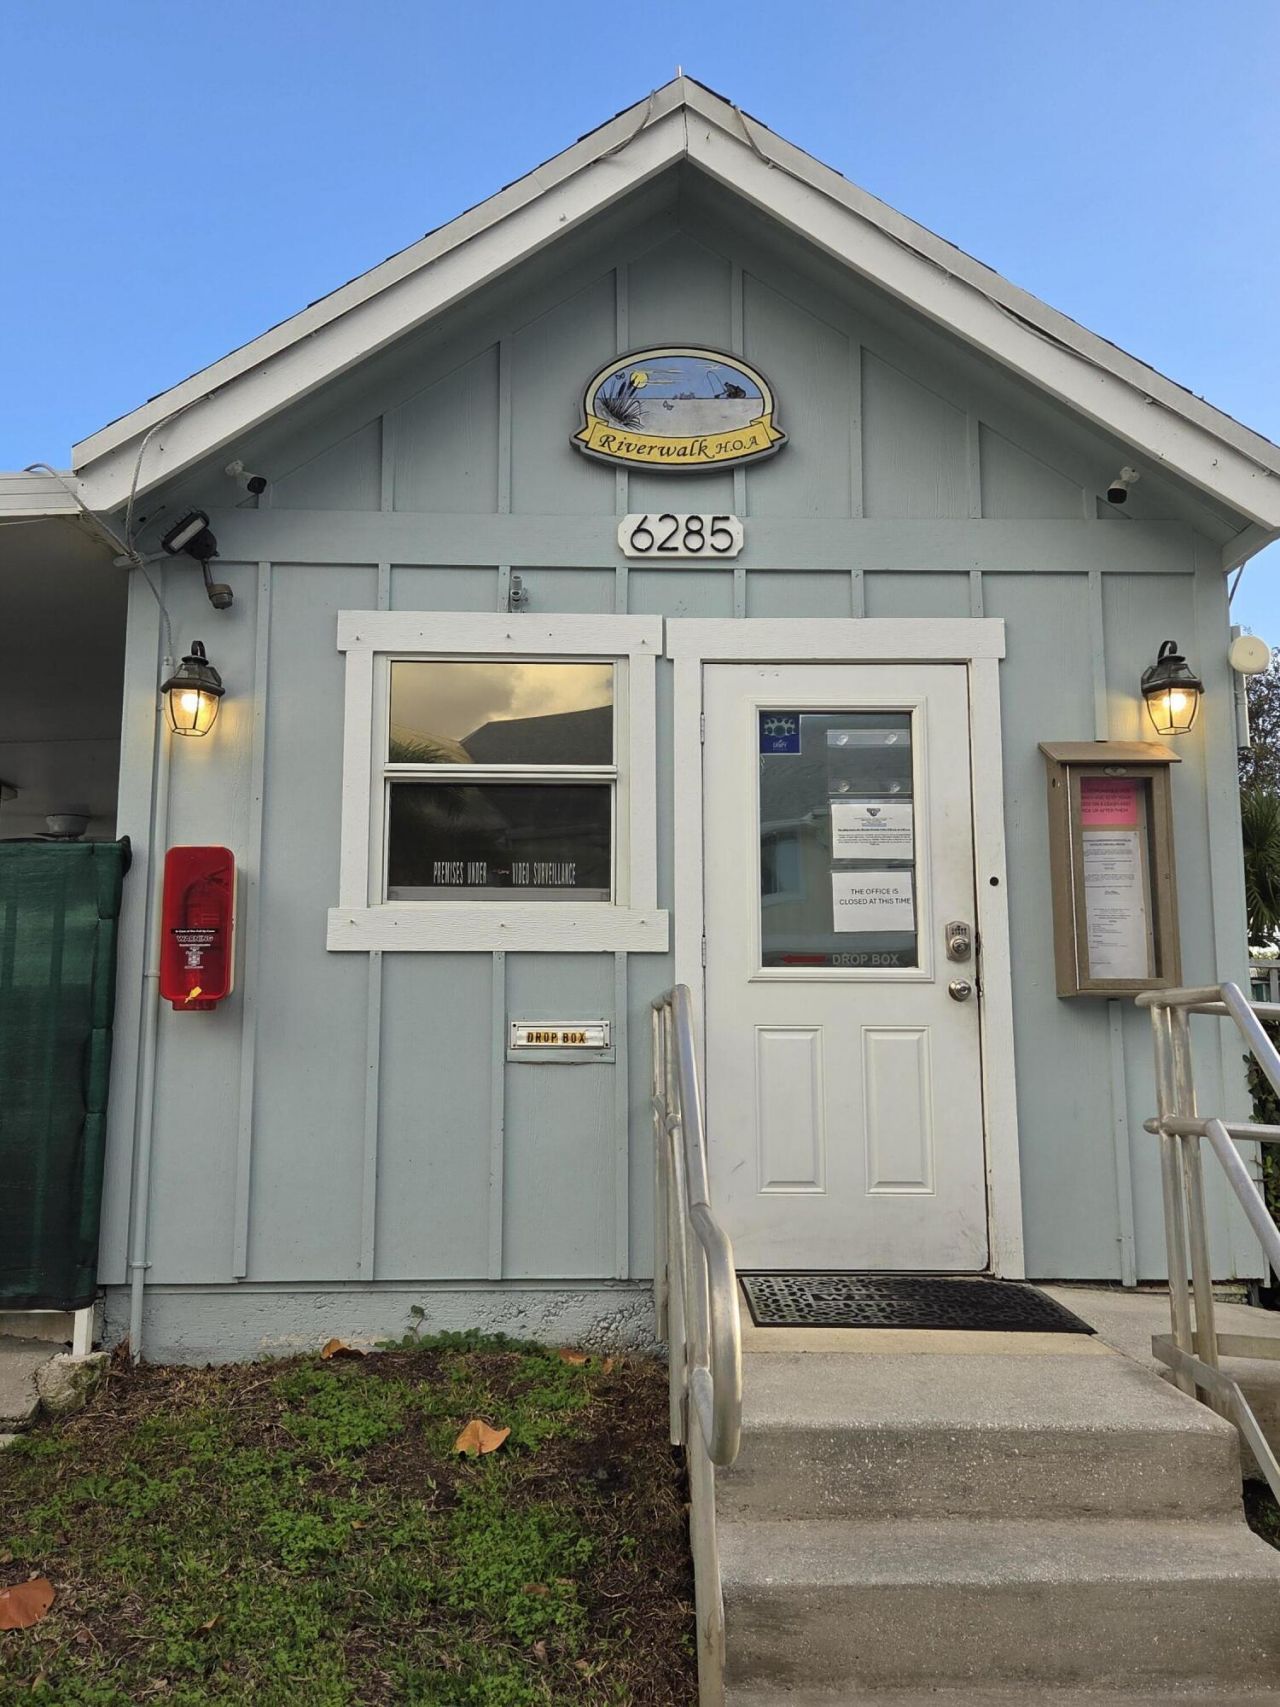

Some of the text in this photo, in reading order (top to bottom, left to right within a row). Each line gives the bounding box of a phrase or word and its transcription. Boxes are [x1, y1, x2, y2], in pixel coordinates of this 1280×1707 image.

[599, 434, 759, 459] Riverwalk H.O.A
[630, 513, 734, 553] 6285
[433, 861, 576, 885] PREMISES UNDER VIDEO SURVEILLANCE
[832, 954, 899, 965] DROP BOX
[526, 1031, 586, 1044] DROP BOX
